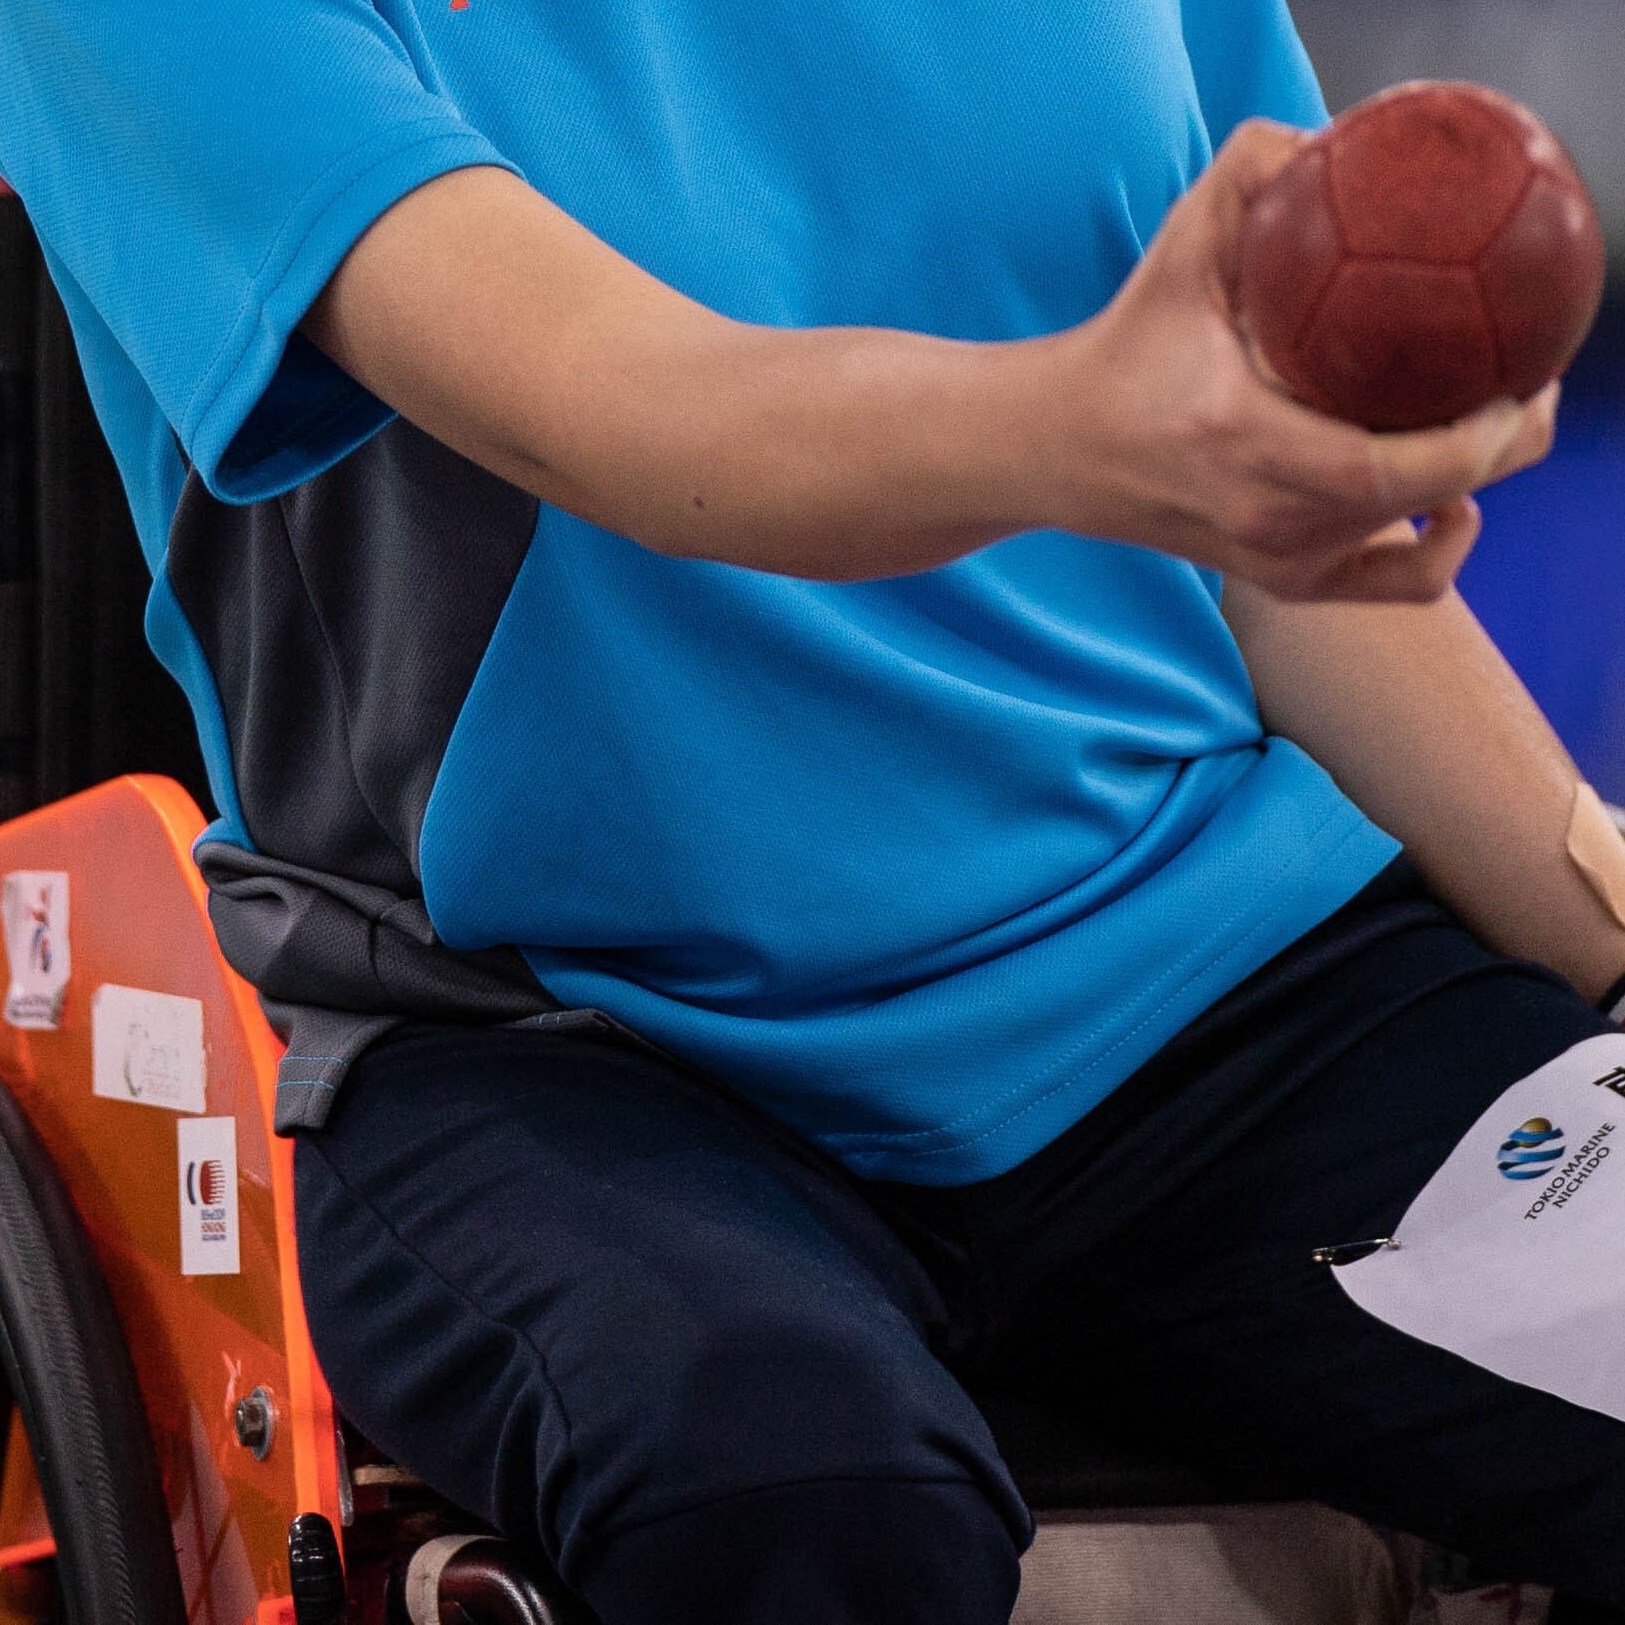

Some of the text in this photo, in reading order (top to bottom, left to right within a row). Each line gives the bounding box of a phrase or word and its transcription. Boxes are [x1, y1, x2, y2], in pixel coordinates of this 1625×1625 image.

[1524, 1122, 1616, 1220] TOKIO MARINE
[1552, 1146, 1610, 1208] NICHIDO
